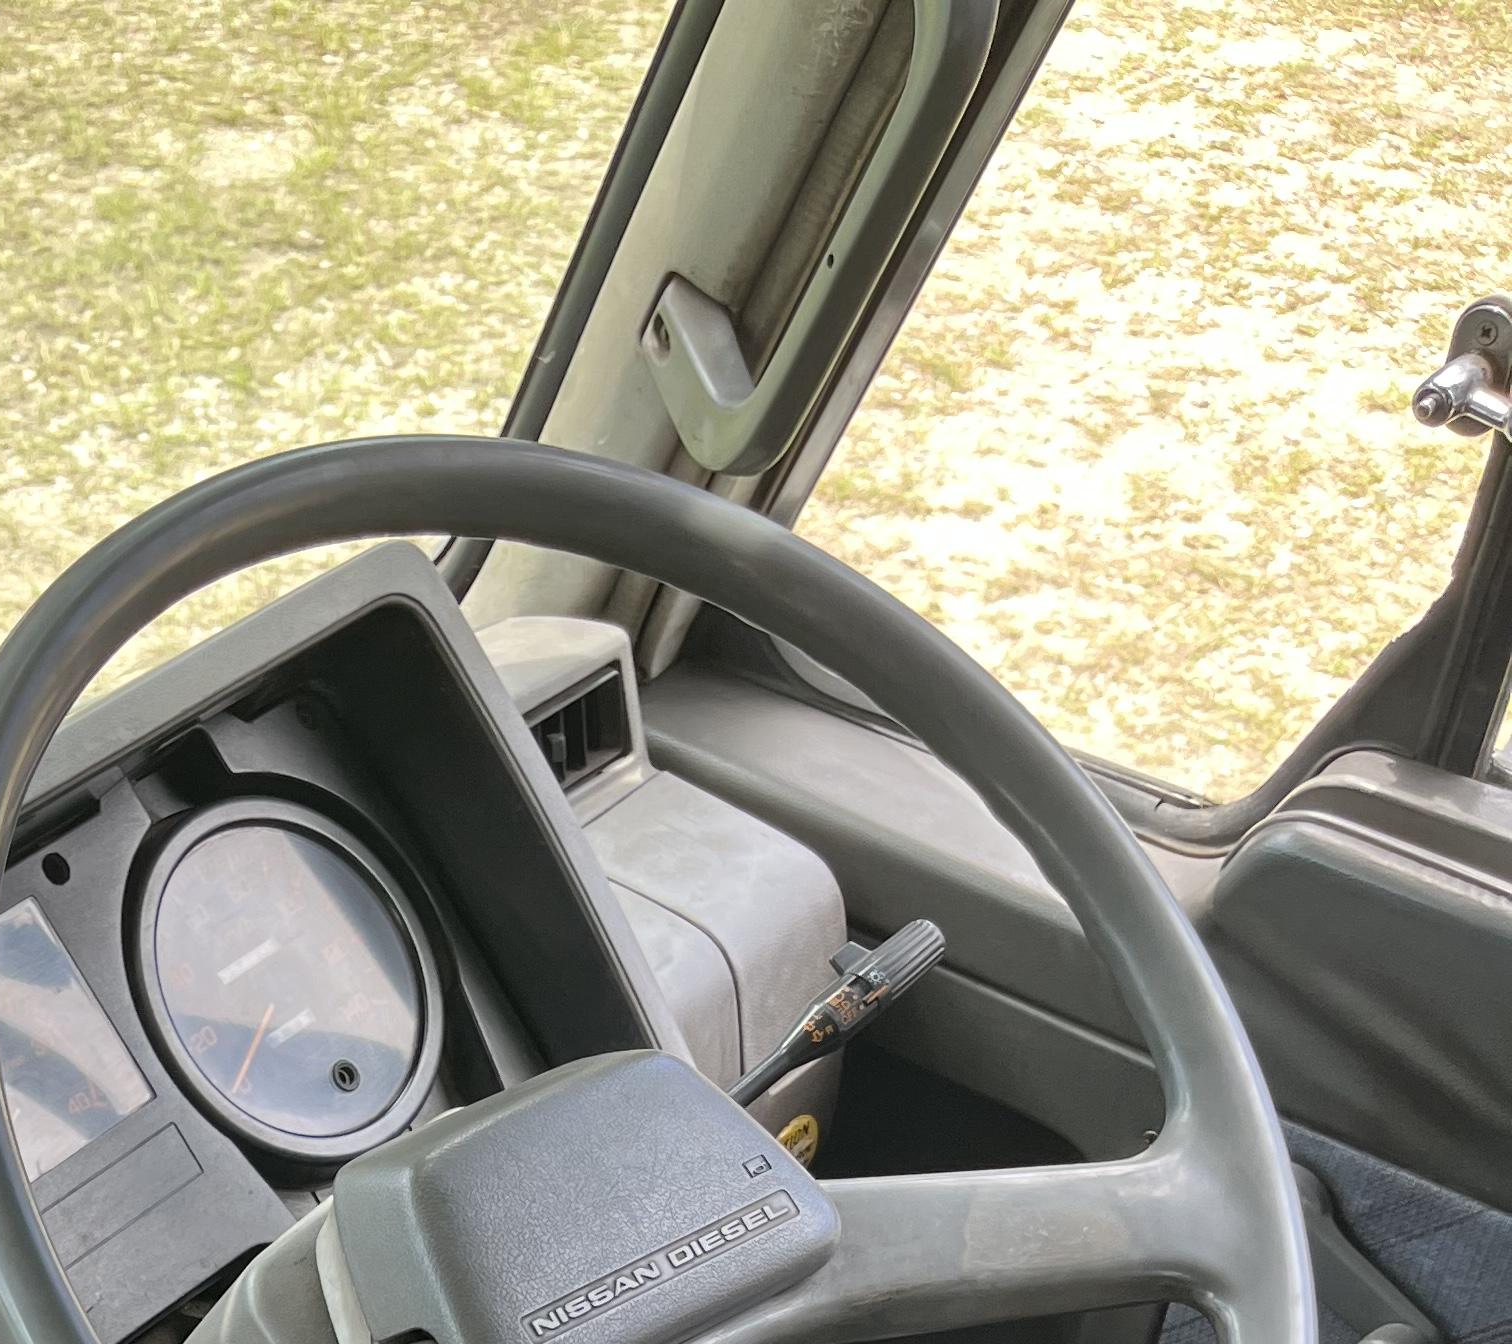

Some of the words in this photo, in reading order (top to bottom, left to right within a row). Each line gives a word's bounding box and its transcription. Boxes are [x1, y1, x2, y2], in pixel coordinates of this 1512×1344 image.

[192, 1025, 218, 1053] 20
[532, 1262, 661, 1336] NISSAN
[667, 1204, 790, 1269] DIESEL
